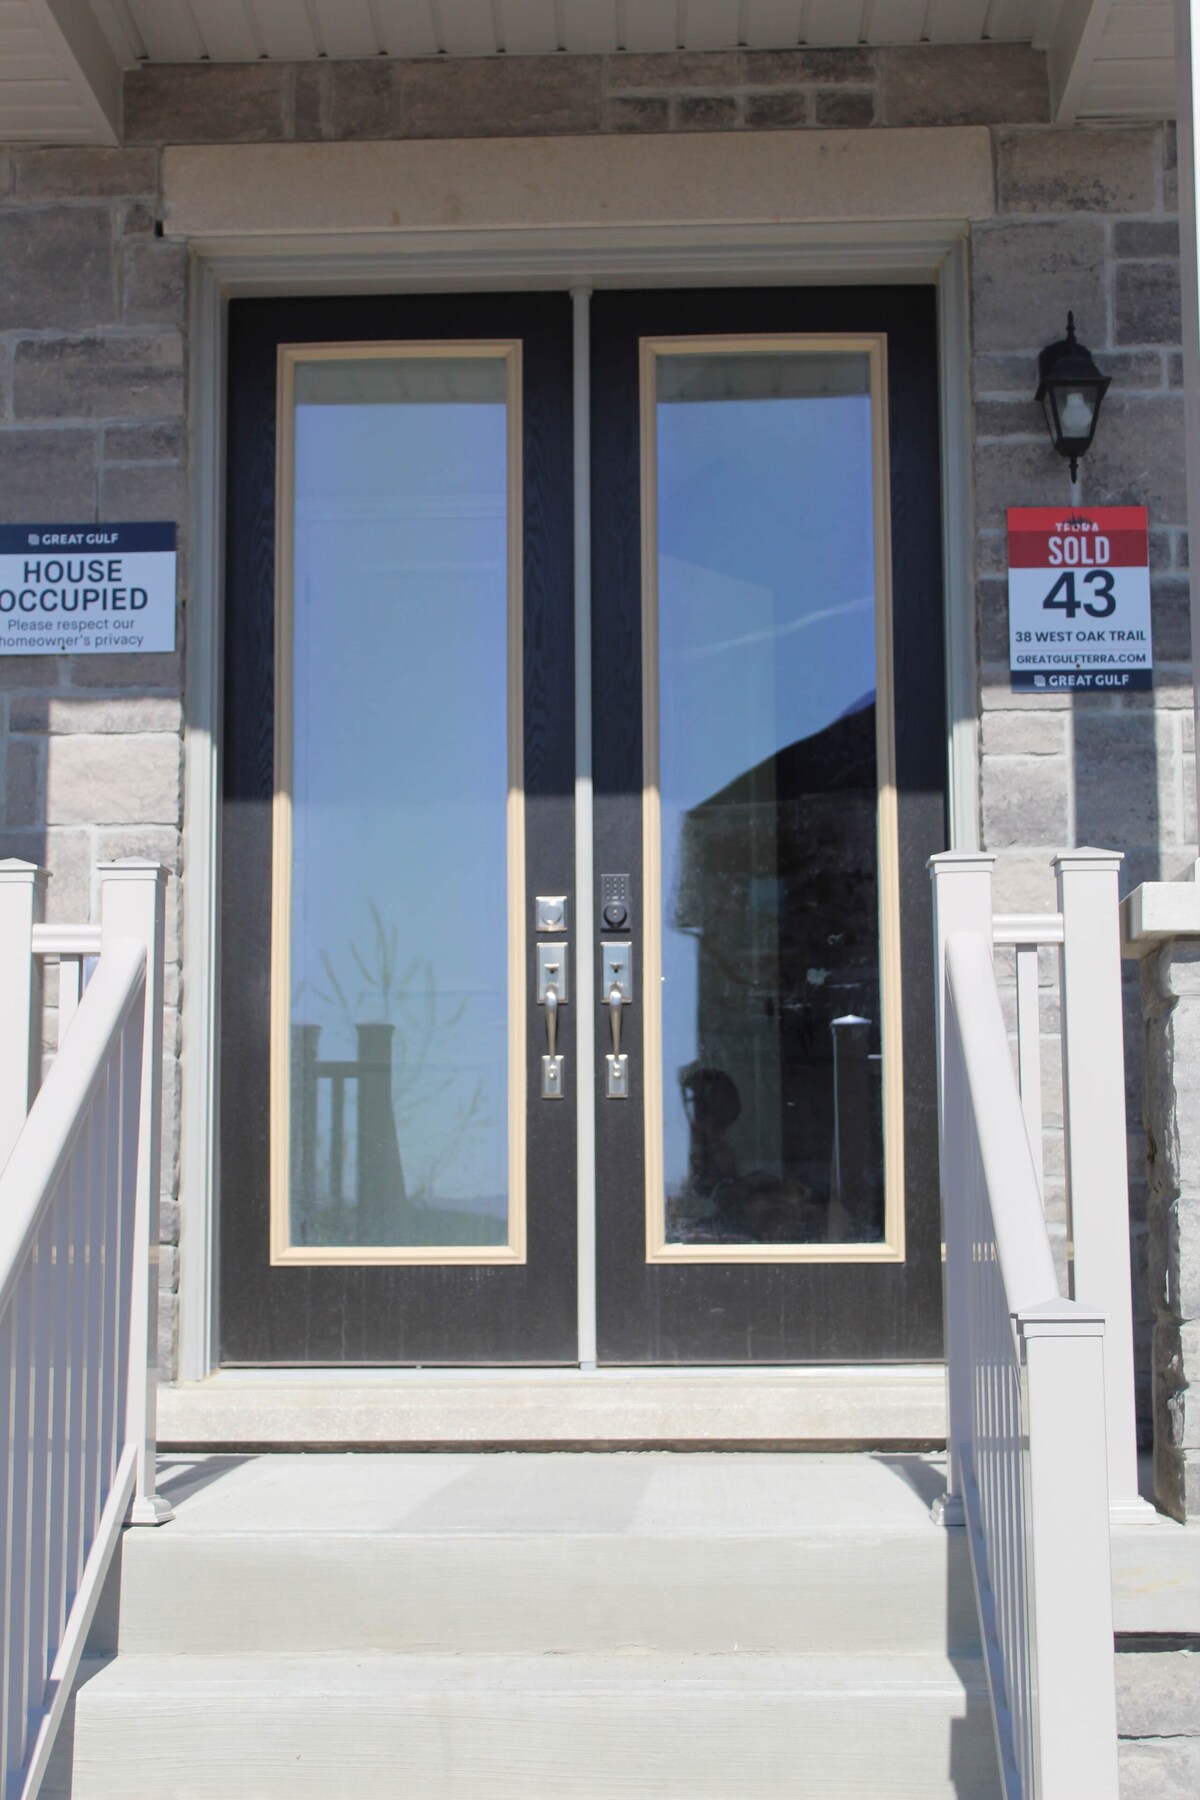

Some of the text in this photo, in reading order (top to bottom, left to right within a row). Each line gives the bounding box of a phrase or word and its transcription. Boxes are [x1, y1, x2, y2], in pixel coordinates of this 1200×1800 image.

[42, 533, 119, 545] GREAT GULF
[1048, 536, 1110, 565] SOLD
[24, 560, 122, 583] HOUSE
[0, 588, 148, 612] OCCUPIED
[1043, 569, 1117, 618] 43
[8, 619, 135, 633] Please respect our
[95, 635, 144, 648] privacy
[1015, 630, 1147, 642] 38 WEST OAK TRAIL
[1016, 653, 1147, 665] GREATGULFTERRA.COM
[1048, 674, 1129, 687] GREAT GULF
